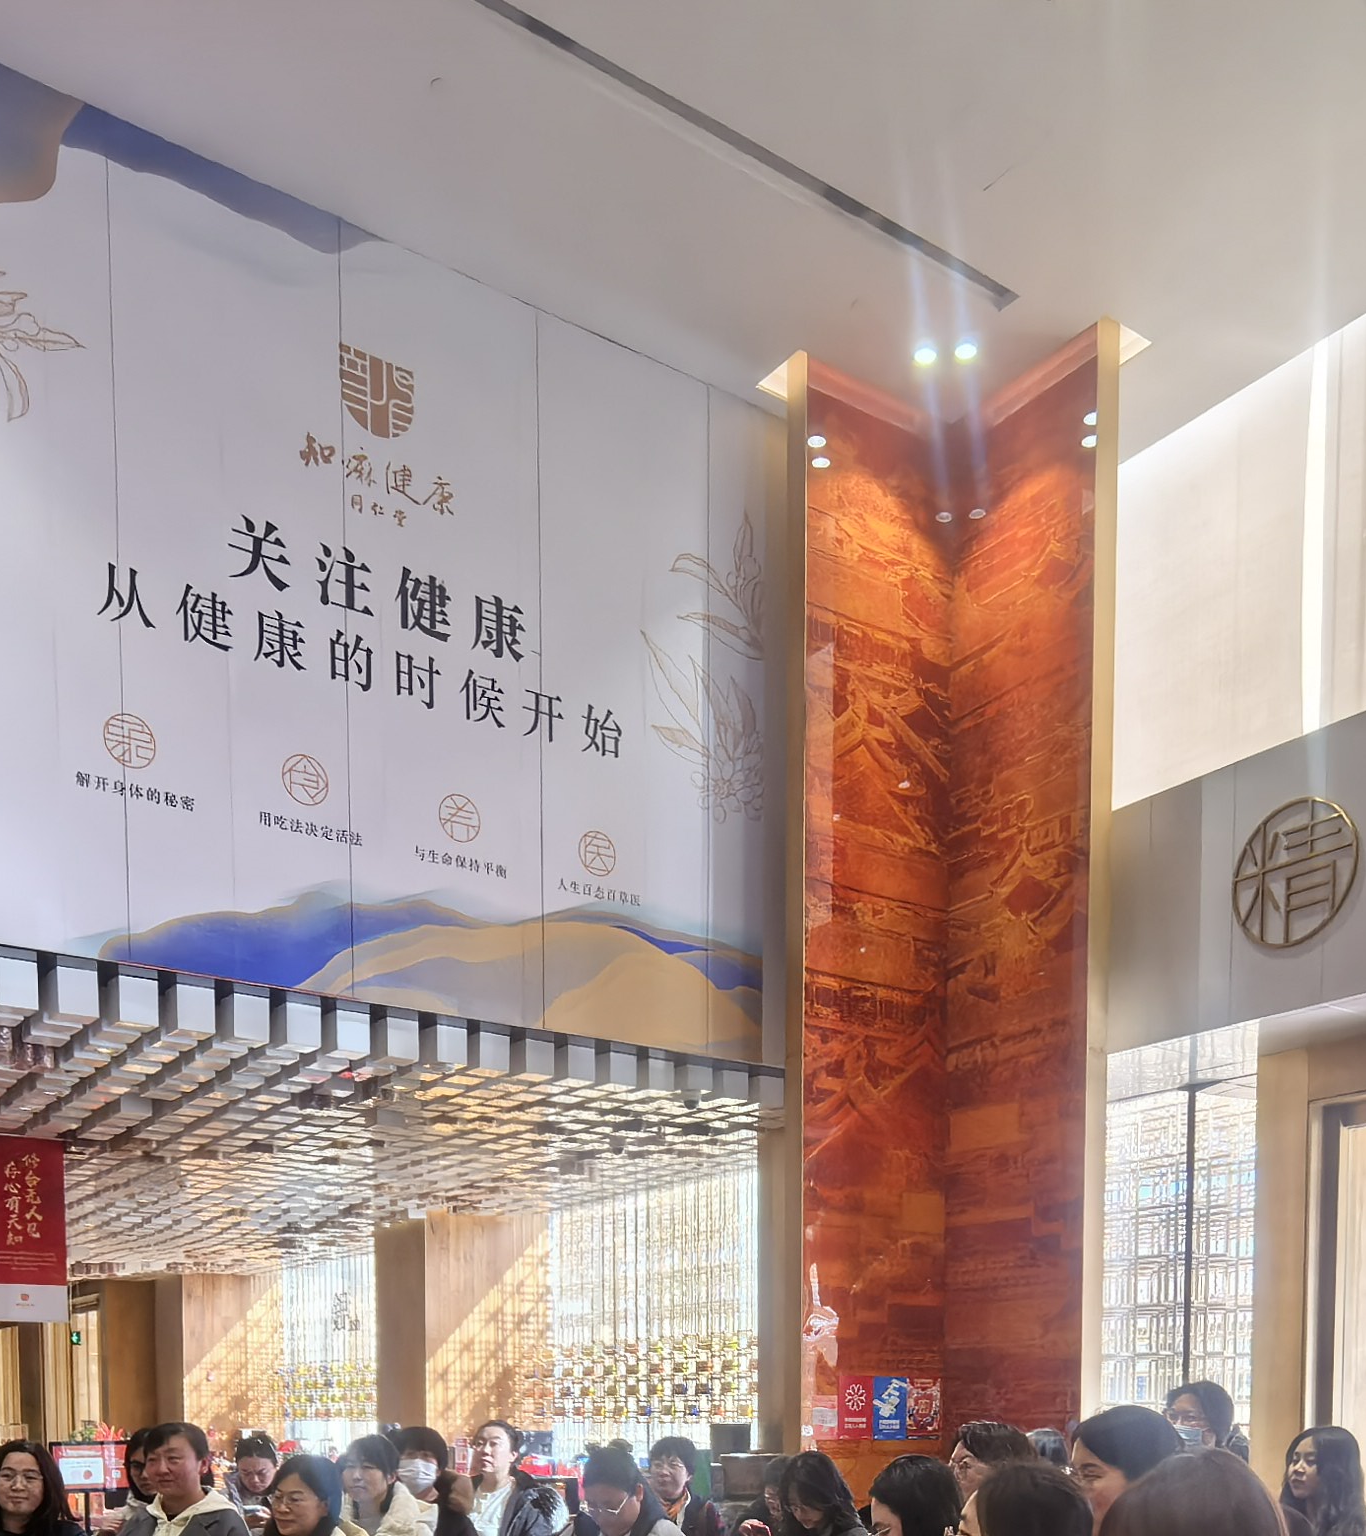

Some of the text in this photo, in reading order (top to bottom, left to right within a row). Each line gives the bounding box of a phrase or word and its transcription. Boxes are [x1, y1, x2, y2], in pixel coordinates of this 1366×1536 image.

[227, 513, 525, 662] 关注健康
[97, 562, 624, 759] 从健康的时候开始
[75, 771, 195, 811] 解开身体的秘密
[258, 811, 364, 847] 用吃法决定活法
[414, 845, 508, 880] 与生命保持平衡
[1233, 797, 1358, 948] 精
[557, 877, 641, 907] 人生百态百草医
